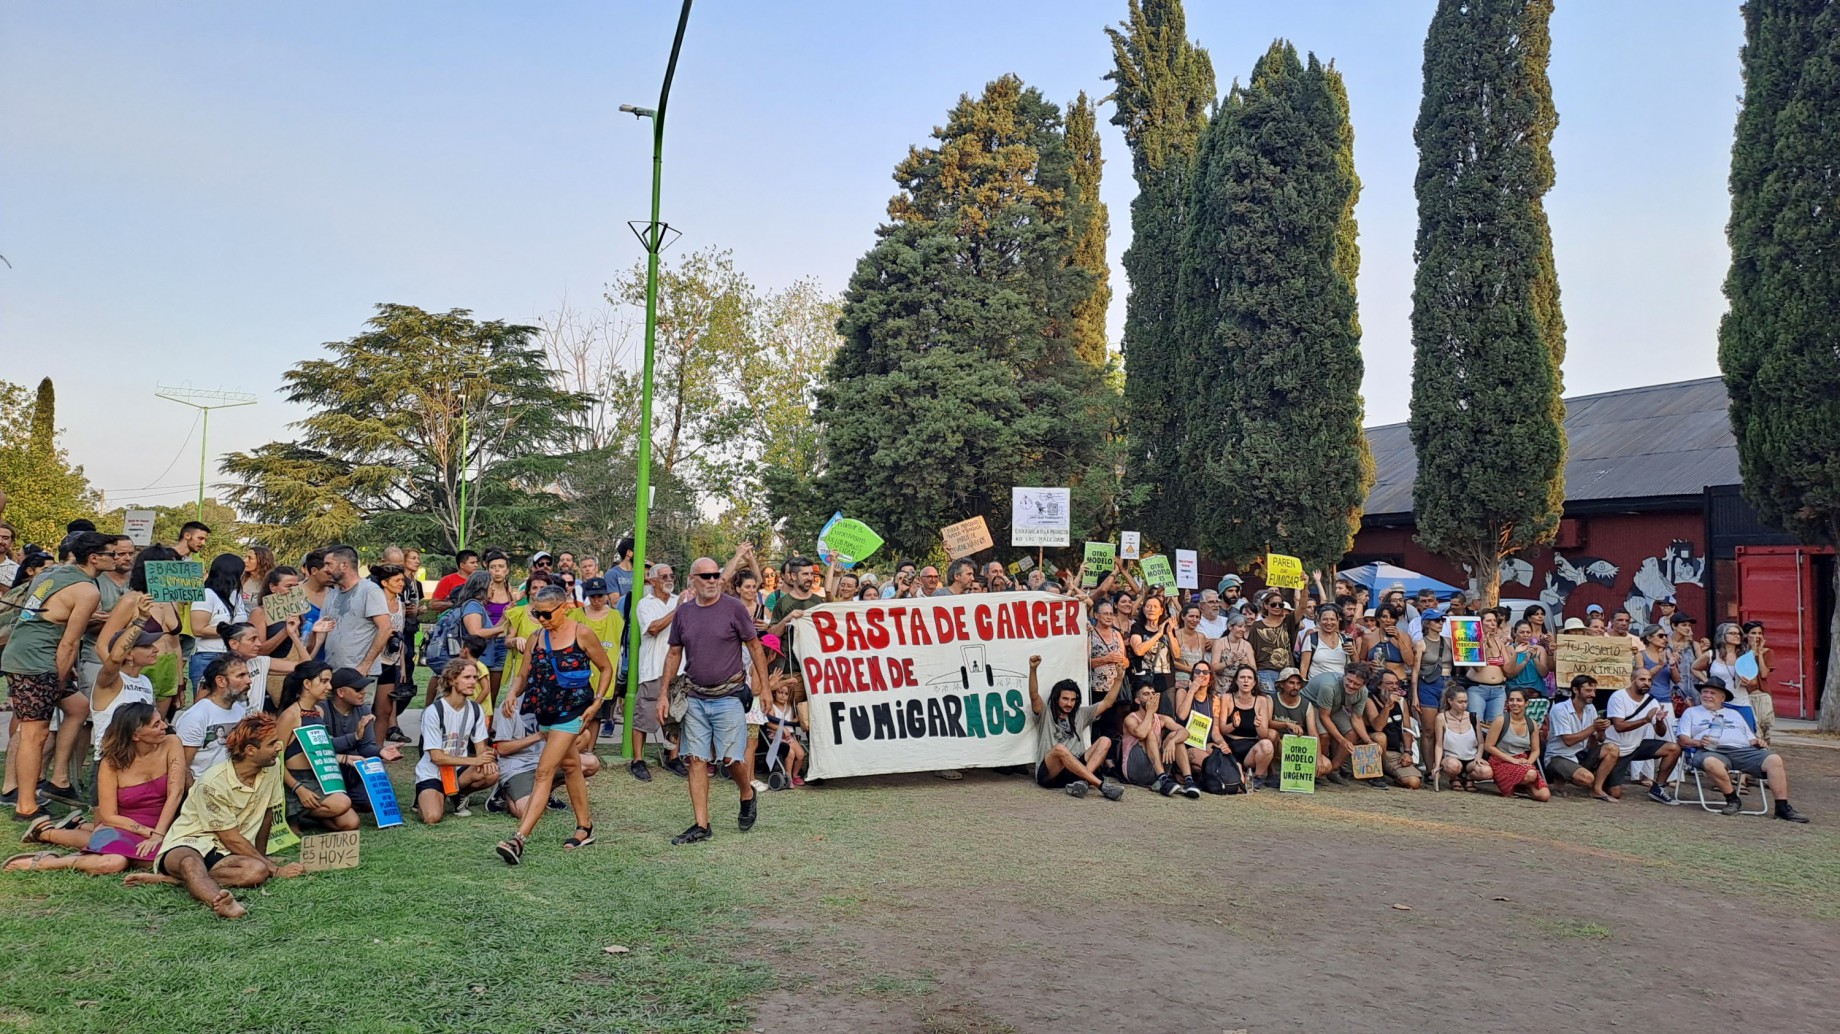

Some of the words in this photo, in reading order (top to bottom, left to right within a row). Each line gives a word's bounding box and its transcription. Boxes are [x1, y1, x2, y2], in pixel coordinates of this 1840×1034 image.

[1272, 557, 1296, 568] PAREN
[156, 562, 190, 578] BASTA
[1148, 568, 1170, 577] MODELO
[1268, 574, 1300, 588] FUMIGAR
[162, 588, 204, 602] PROTESTA
[811, 606, 932, 653] BASTA
[933, 606, 970, 644] DE
[974, 600, 1080, 642] CANCER
[804, 656, 887, 695] PAREN
[887, 654, 918, 688] DE
[1573, 664, 1586, 672] NO
[1589, 664, 1628, 674] ALIMENTA
[1290, 746, 1307, 754] OTRO
[1284, 754, 1314, 763] MODELO
[1283, 772, 1312, 781] URGENTE
[304, 836, 315, 848] EL
[320, 833, 358, 850] FUTURO
[302, 850, 316, 860] es
[320, 850, 345, 865] HOY
